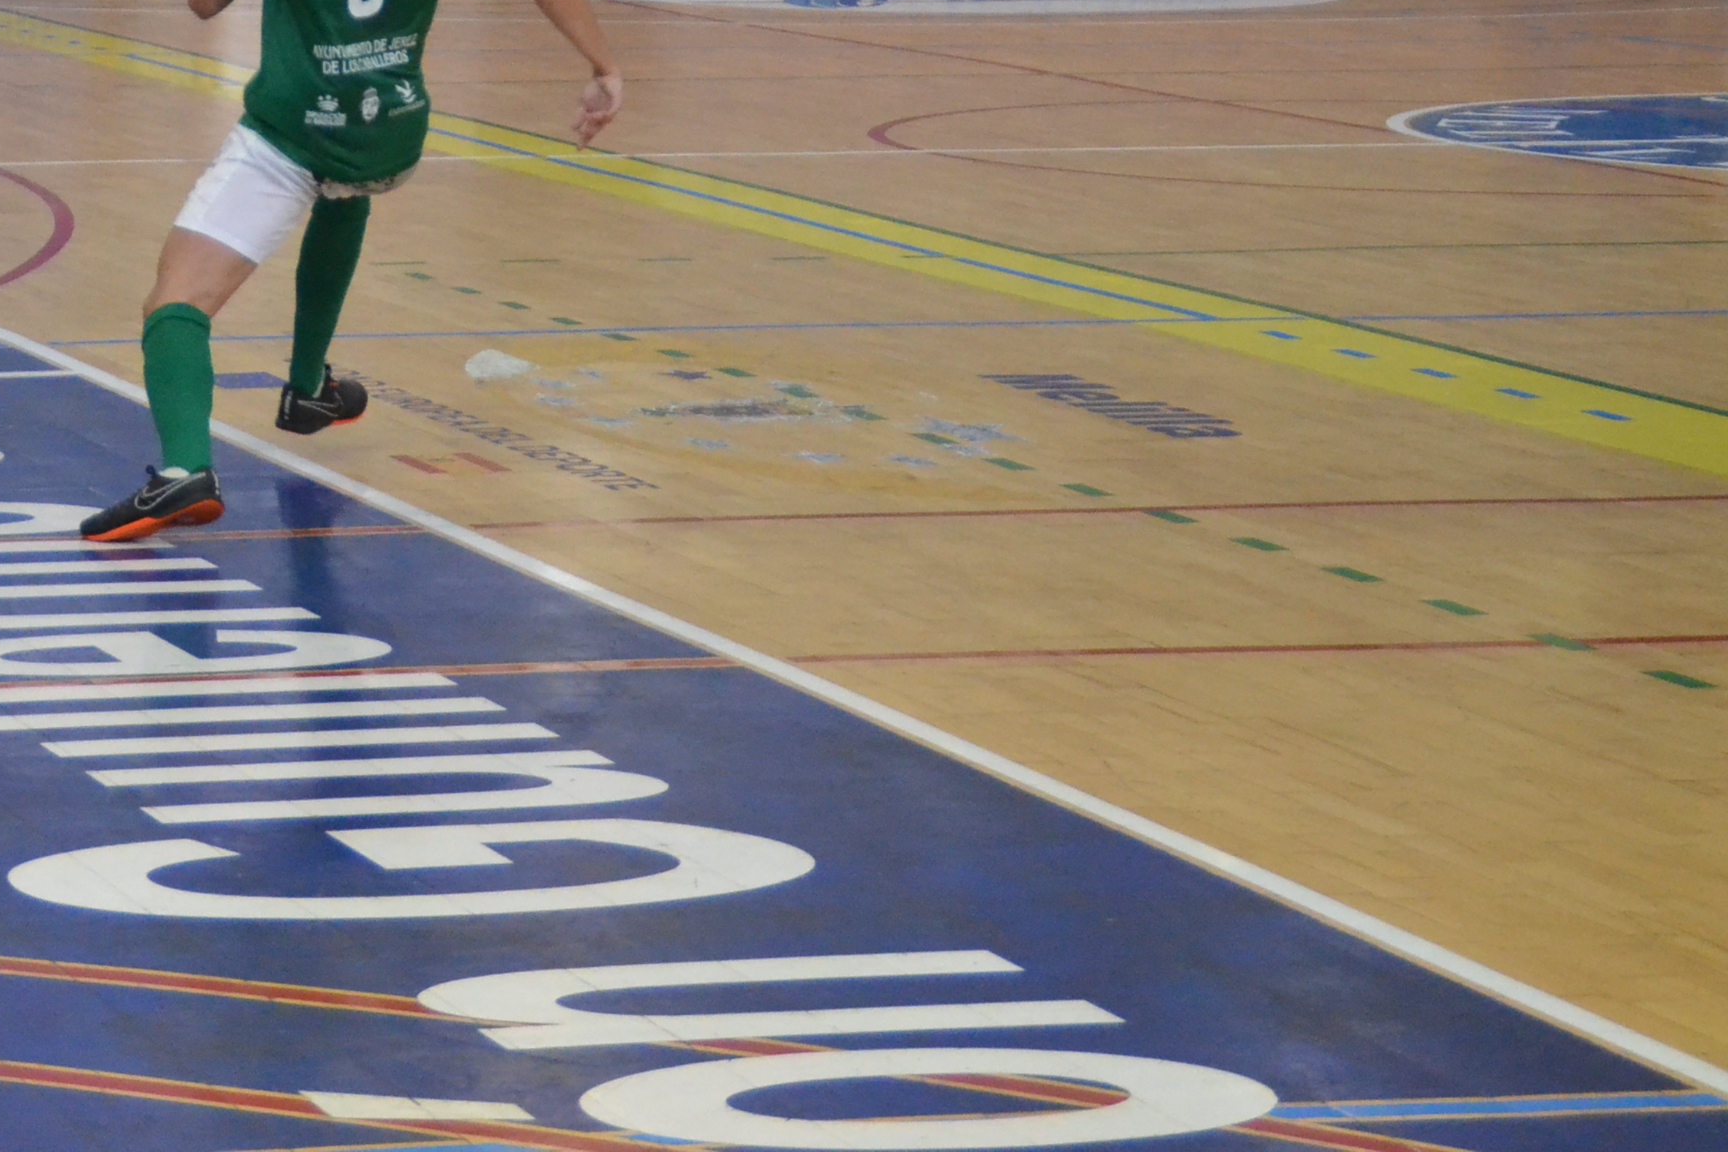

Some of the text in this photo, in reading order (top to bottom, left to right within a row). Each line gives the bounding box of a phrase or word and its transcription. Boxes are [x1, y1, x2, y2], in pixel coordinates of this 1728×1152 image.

[373, 38, 388, 53] DE
[322, 59, 340, 75] DE
[976, 373, 1243, 438] Melilla
[505, 445, 661, 491] DEPORTE
